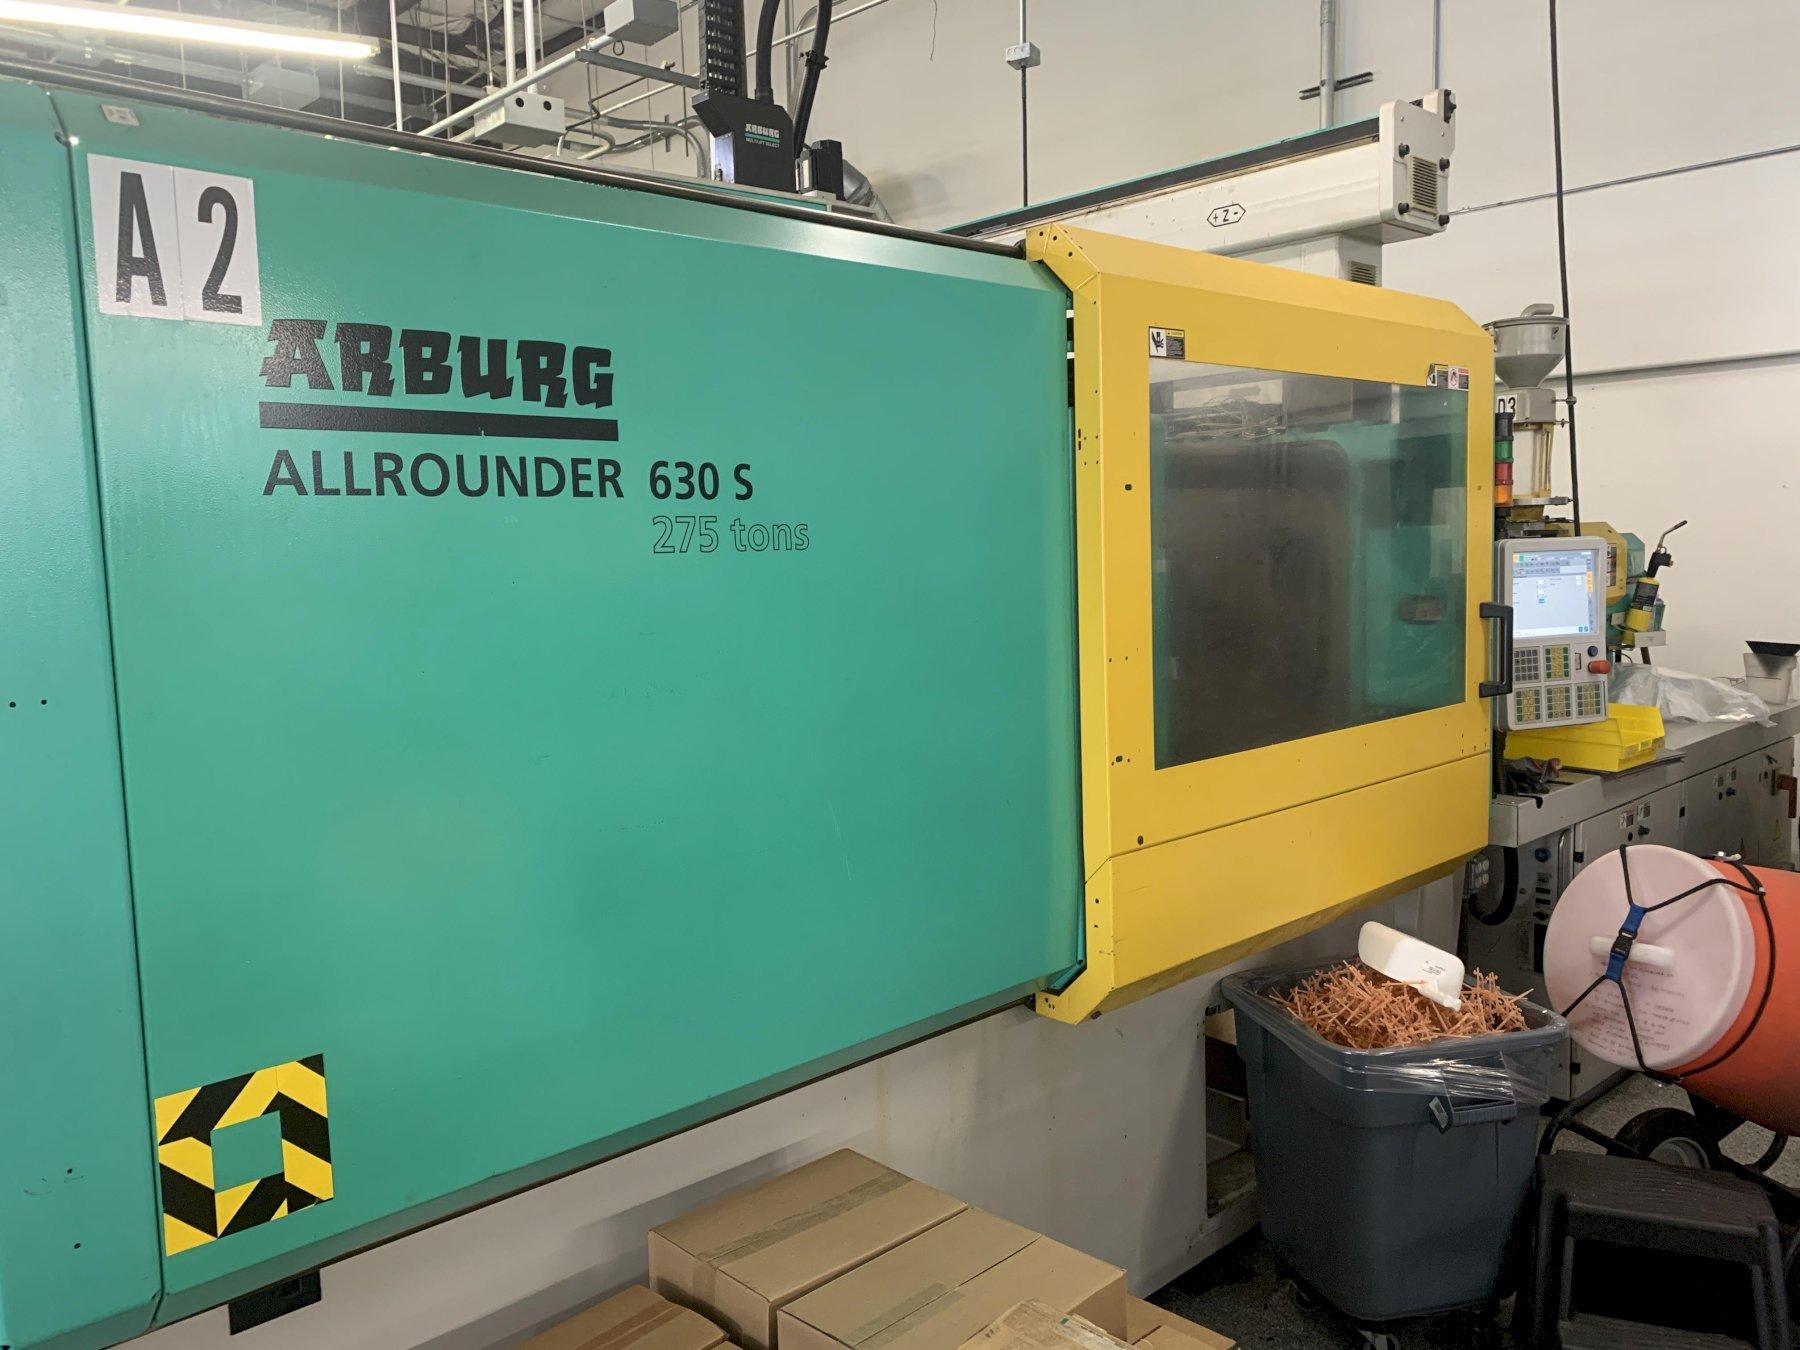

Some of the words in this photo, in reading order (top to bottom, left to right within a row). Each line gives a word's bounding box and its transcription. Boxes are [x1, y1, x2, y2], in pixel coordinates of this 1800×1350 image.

[745, 123, 780, 139] ARBURG
[258, 318, 615, 409] ARBURG
[262, 449, 625, 499] ALLROUNDER
[649, 460, 720, 501] 630
[733, 463, 754, 501] S
[652, 515, 720, 554] 275
[729, 517, 810, 553] tons
